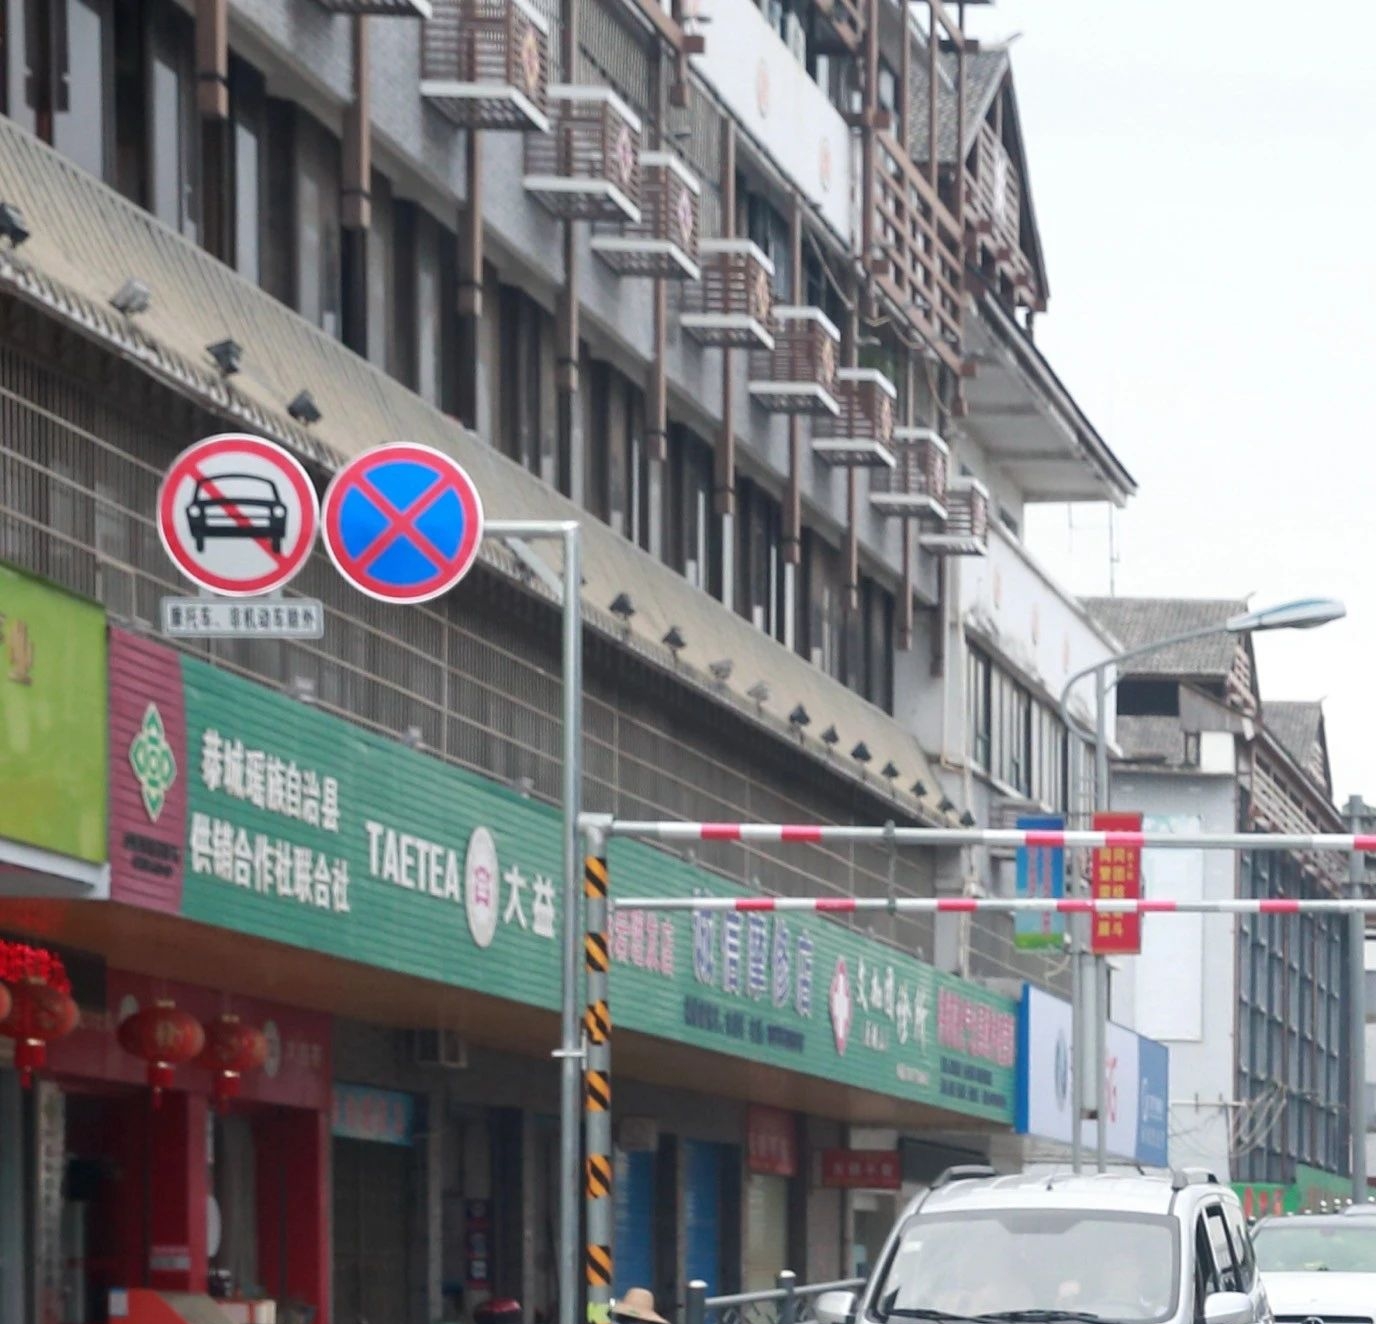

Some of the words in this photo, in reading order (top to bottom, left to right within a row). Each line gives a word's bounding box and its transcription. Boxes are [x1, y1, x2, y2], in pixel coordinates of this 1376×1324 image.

[202, 728, 341, 832] 恭城瑶族自治县
[189, 811, 350, 912] 供销合作社联合社
[365, 820, 461, 902] TAETEA
[503, 864, 556, 939] 大益
